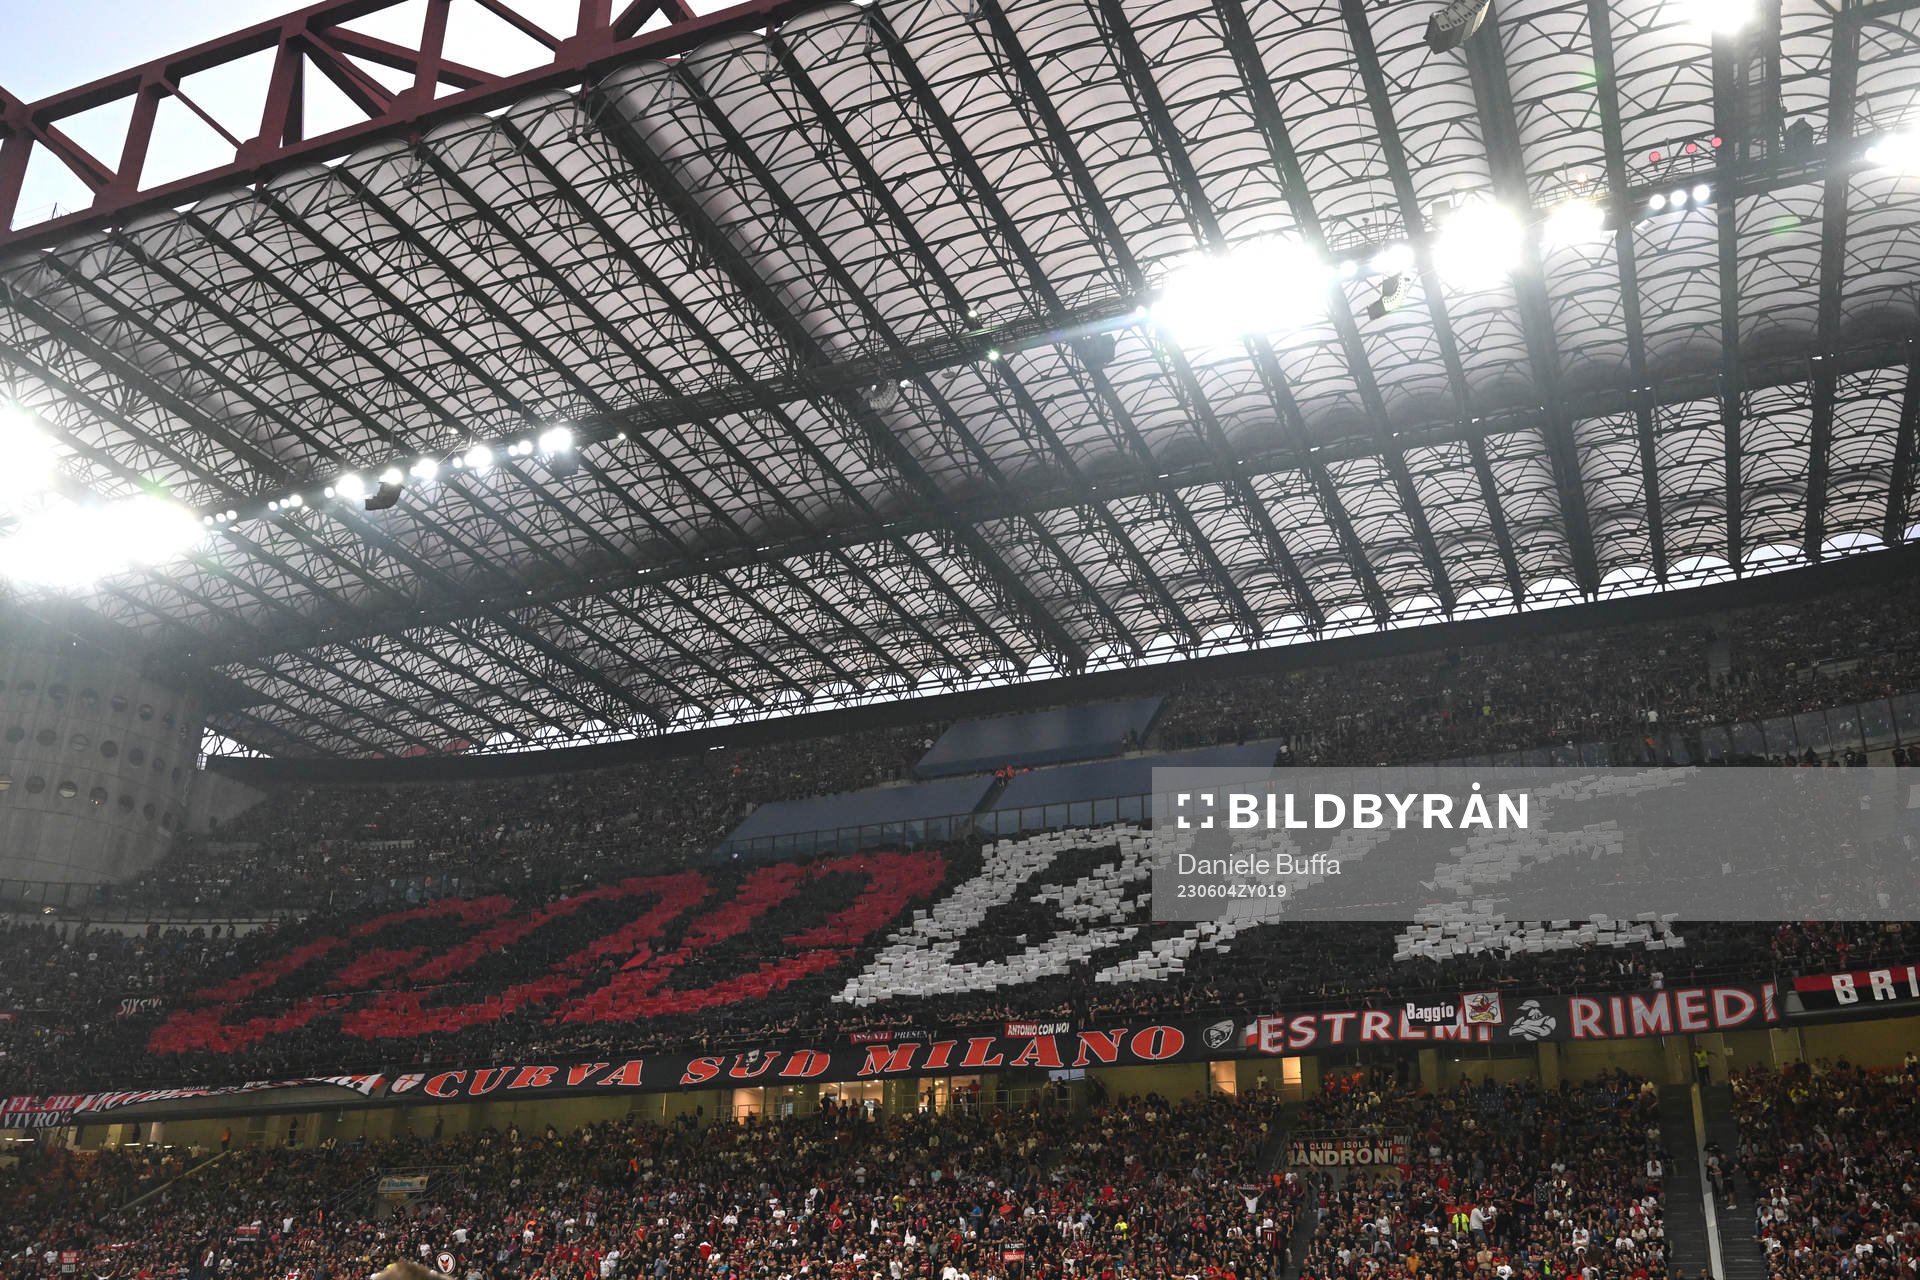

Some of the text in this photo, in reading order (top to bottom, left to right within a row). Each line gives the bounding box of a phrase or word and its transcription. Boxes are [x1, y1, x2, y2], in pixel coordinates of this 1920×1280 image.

[1406, 1001, 1455, 1022] Baggio
[1568, 983, 1779, 1039] RIMEDI
[1007, 1021, 1070, 1036] ANTONIO CON NOI
[424, 1059, 644, 1098] CURVA
[679, 1049, 831, 1086] SUD
[856, 1024, 1185, 1077] MILANO
[1309, 1141, 1333, 1150] CLUB
[1343, 1139, 1370, 1149] ISOLA
